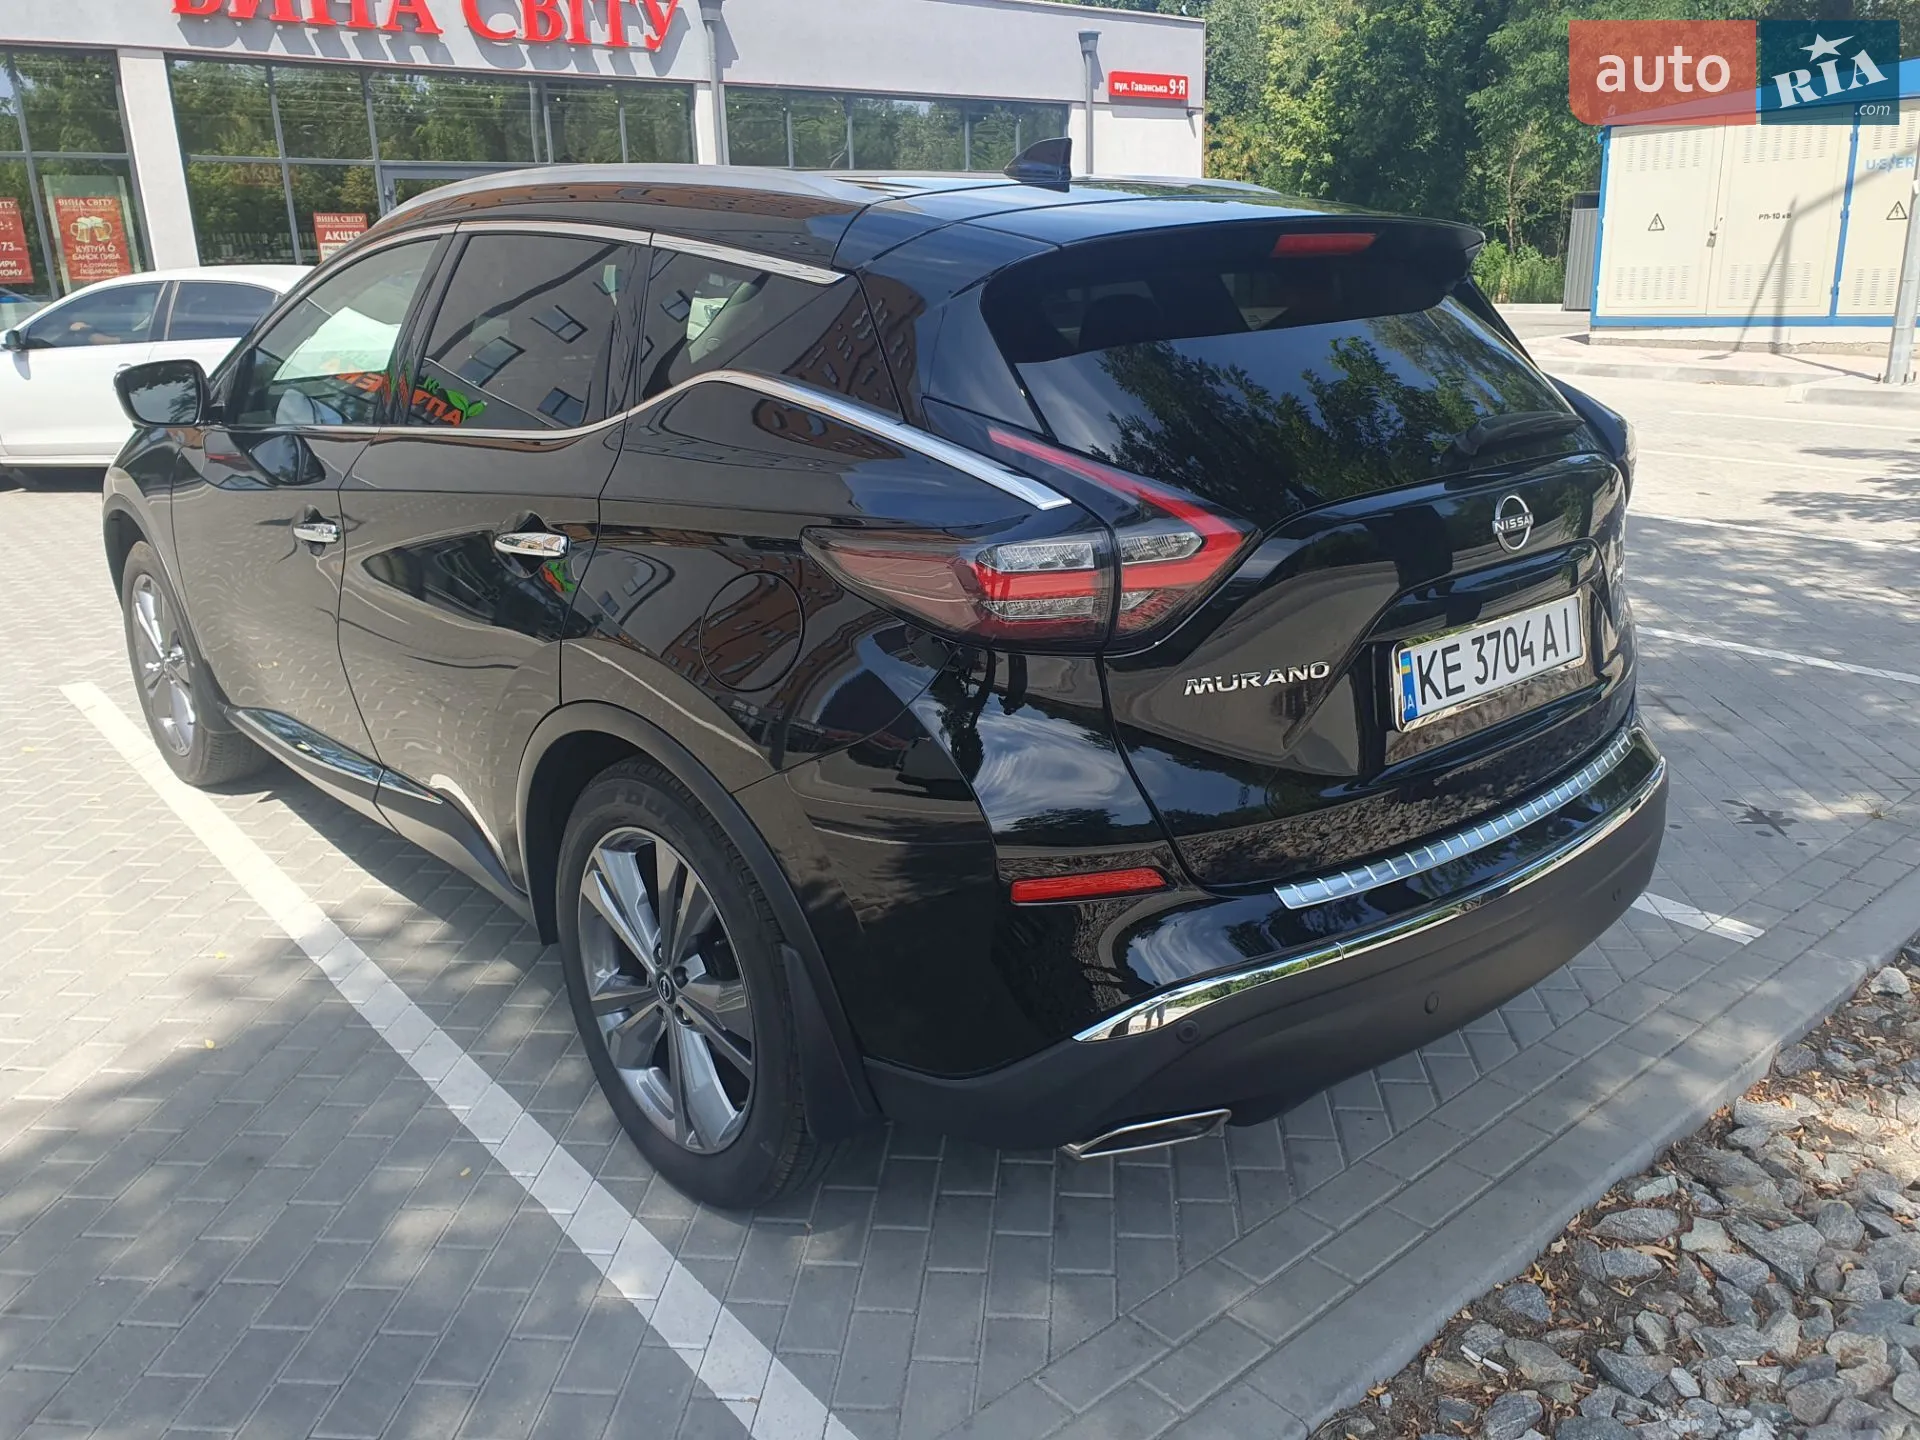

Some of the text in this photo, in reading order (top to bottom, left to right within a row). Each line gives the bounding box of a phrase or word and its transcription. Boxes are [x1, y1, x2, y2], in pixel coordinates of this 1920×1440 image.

[1131, 81, 1168, 93] Гаванська
[1169, 78, 1186, 95] 9-Я
[316, 215, 364, 223] ВИНА СВІТУ
[107, 241, 116, 253] 6
[1416, 643, 1466, 705] KE
[1471, 620, 1535, 685] 3704
[1183, 661, 1331, 696] MURANO
